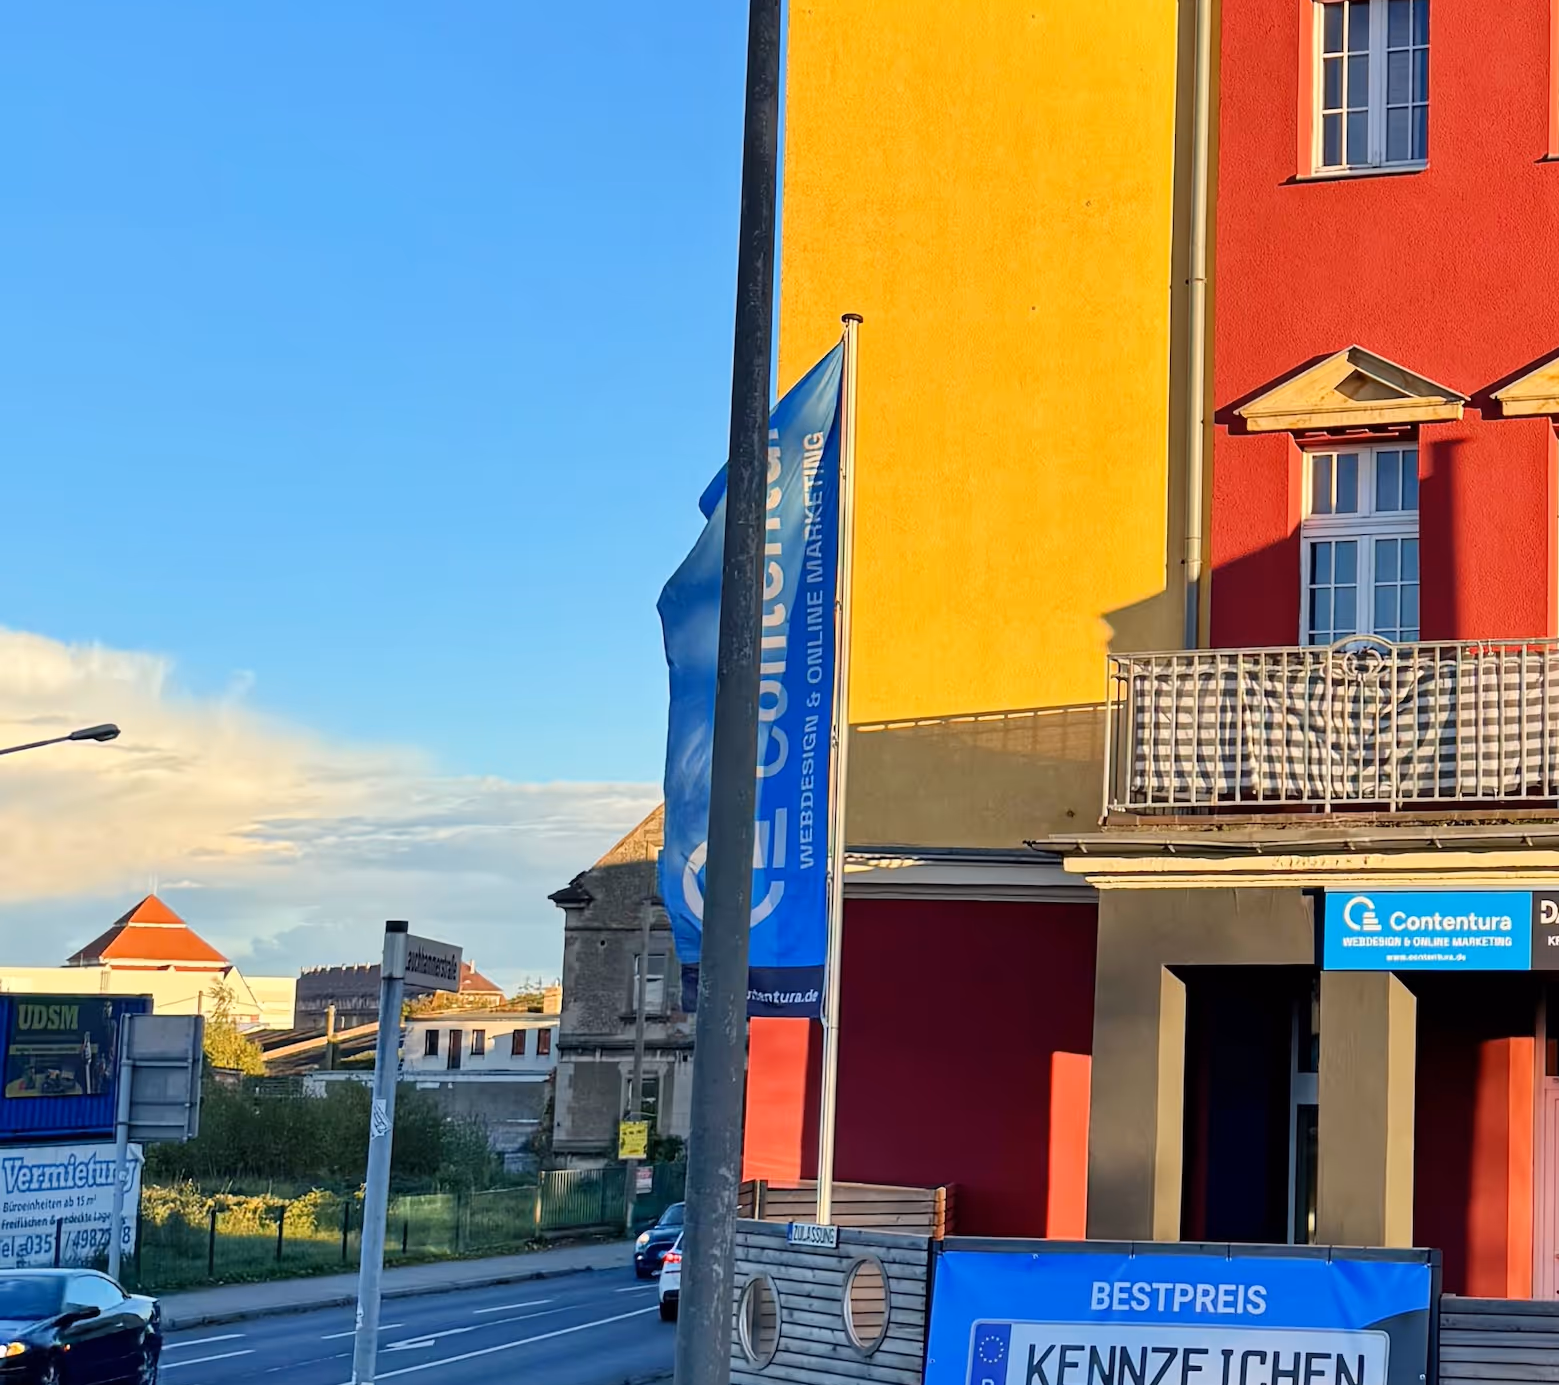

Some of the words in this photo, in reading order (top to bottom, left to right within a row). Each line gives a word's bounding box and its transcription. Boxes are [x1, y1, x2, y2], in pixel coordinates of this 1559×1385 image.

[803, 430, 824, 584] MARKETING
[806, 590, 824, 684] ONLINE
[806, 691, 821, 708] &
[800, 715, 818, 870] WEBDESIGN
[1390, 910, 1512, 931] Contentura
[1342, 936, 1401, 947] WEBDESIGN
[1413, 937, 1449, 947] ONLINE
[1452, 937, 1512, 947] MARKETING
[18, 1004, 80, 1030] UDSM
[64, 1196, 74, 1208] ab
[60, 1212, 92, 1225] edeckte
[794, 1225, 835, 1244] ZULASSUNG
[1090, 1281, 1268, 1315] BESTPREIS
